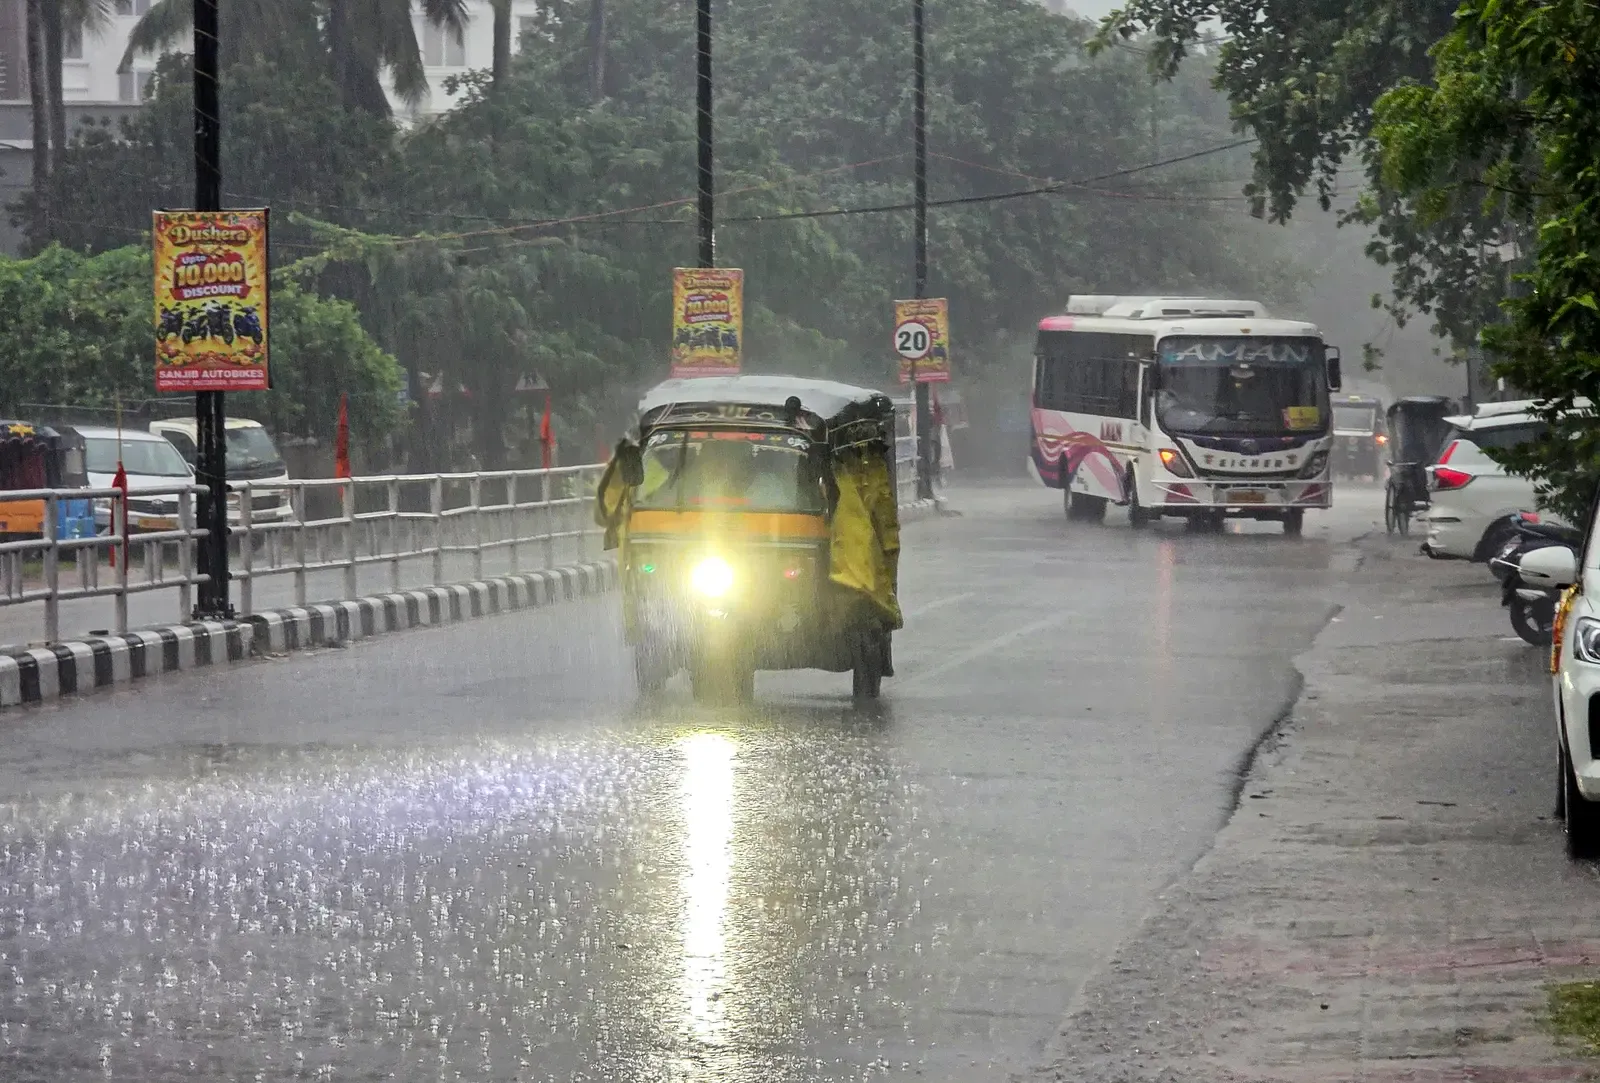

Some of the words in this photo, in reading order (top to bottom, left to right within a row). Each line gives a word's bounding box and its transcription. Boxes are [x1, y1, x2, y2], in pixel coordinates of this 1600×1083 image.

[171, 225, 247, 243] Dushera
[183, 285, 241, 299] DISCOUNT
[898, 331, 927, 351] 20
[1175, 344, 1309, 362] AMAN
[159, 370, 199, 379] SANJIB
[201, 369, 264, 378] AUTOBIKES
[1219, 458, 1283, 467] EICHER
